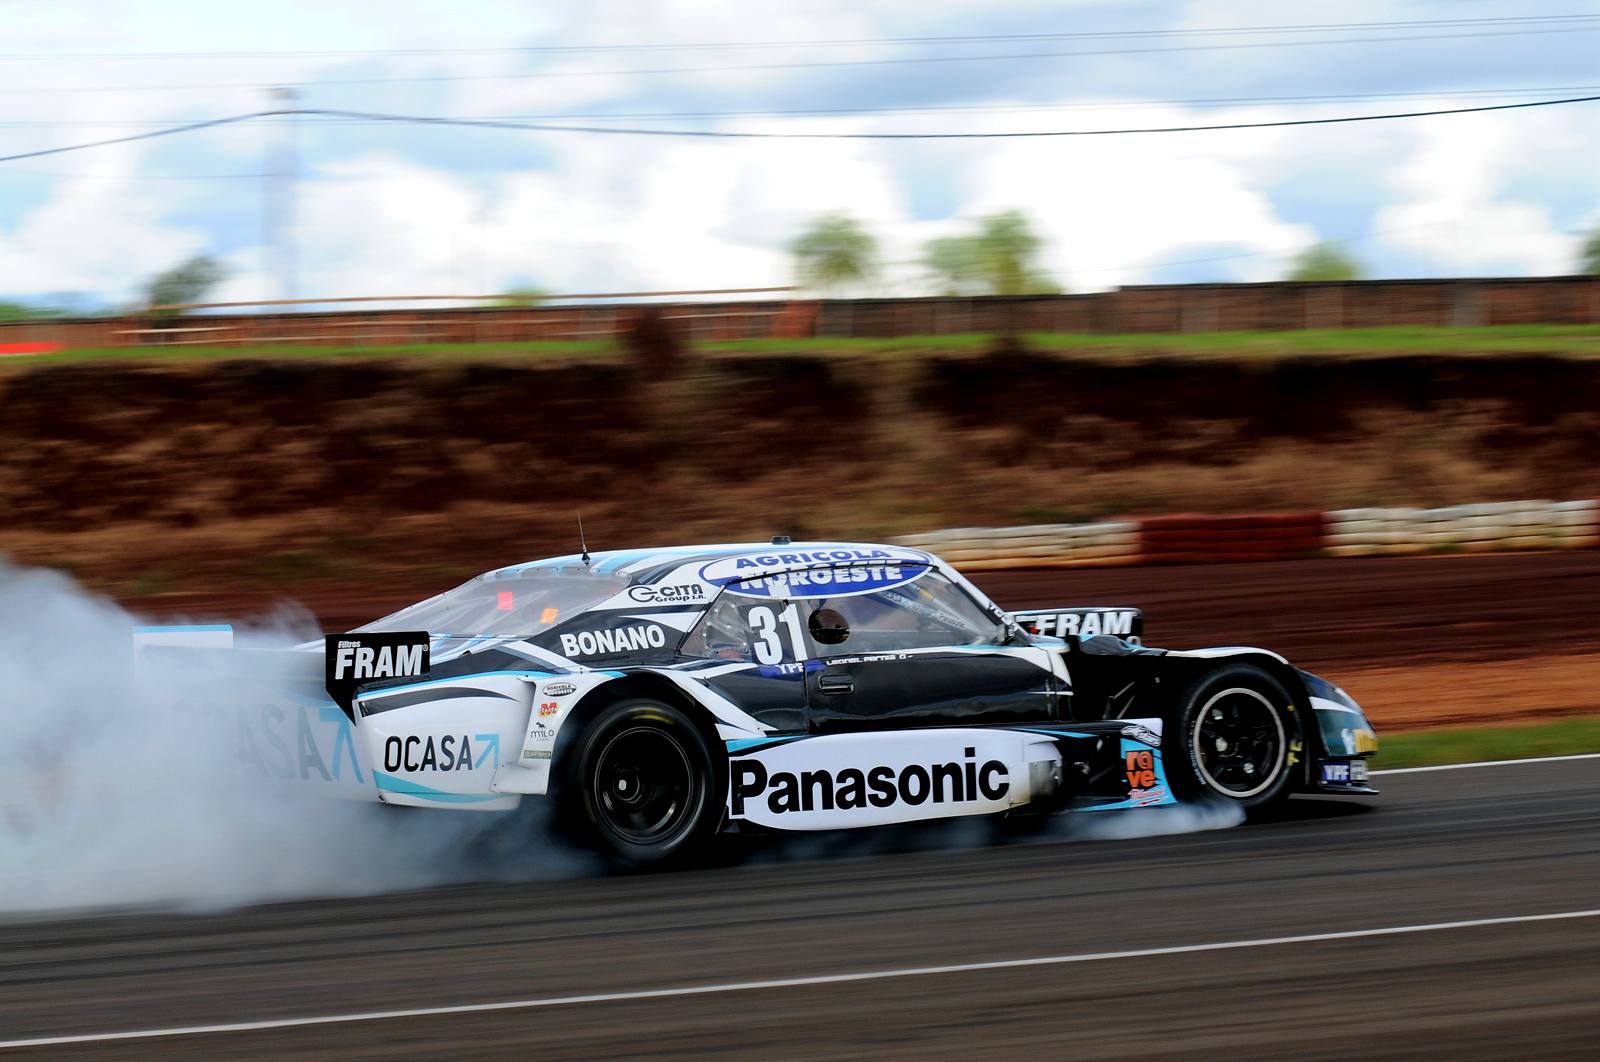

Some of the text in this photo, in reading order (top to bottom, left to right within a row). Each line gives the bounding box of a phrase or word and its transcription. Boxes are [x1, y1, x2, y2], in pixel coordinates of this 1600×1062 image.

[736, 549, 893, 569] AGRICOLA
[740, 560, 903, 590] NOROESTE
[560, 624, 666, 657] BONANO
[748, 603, 808, 665] 31
[335, 644, 423, 680] FRAM
[384, 735, 473, 773] OCASA
[730, 747, 1009, 816] Panasonic
